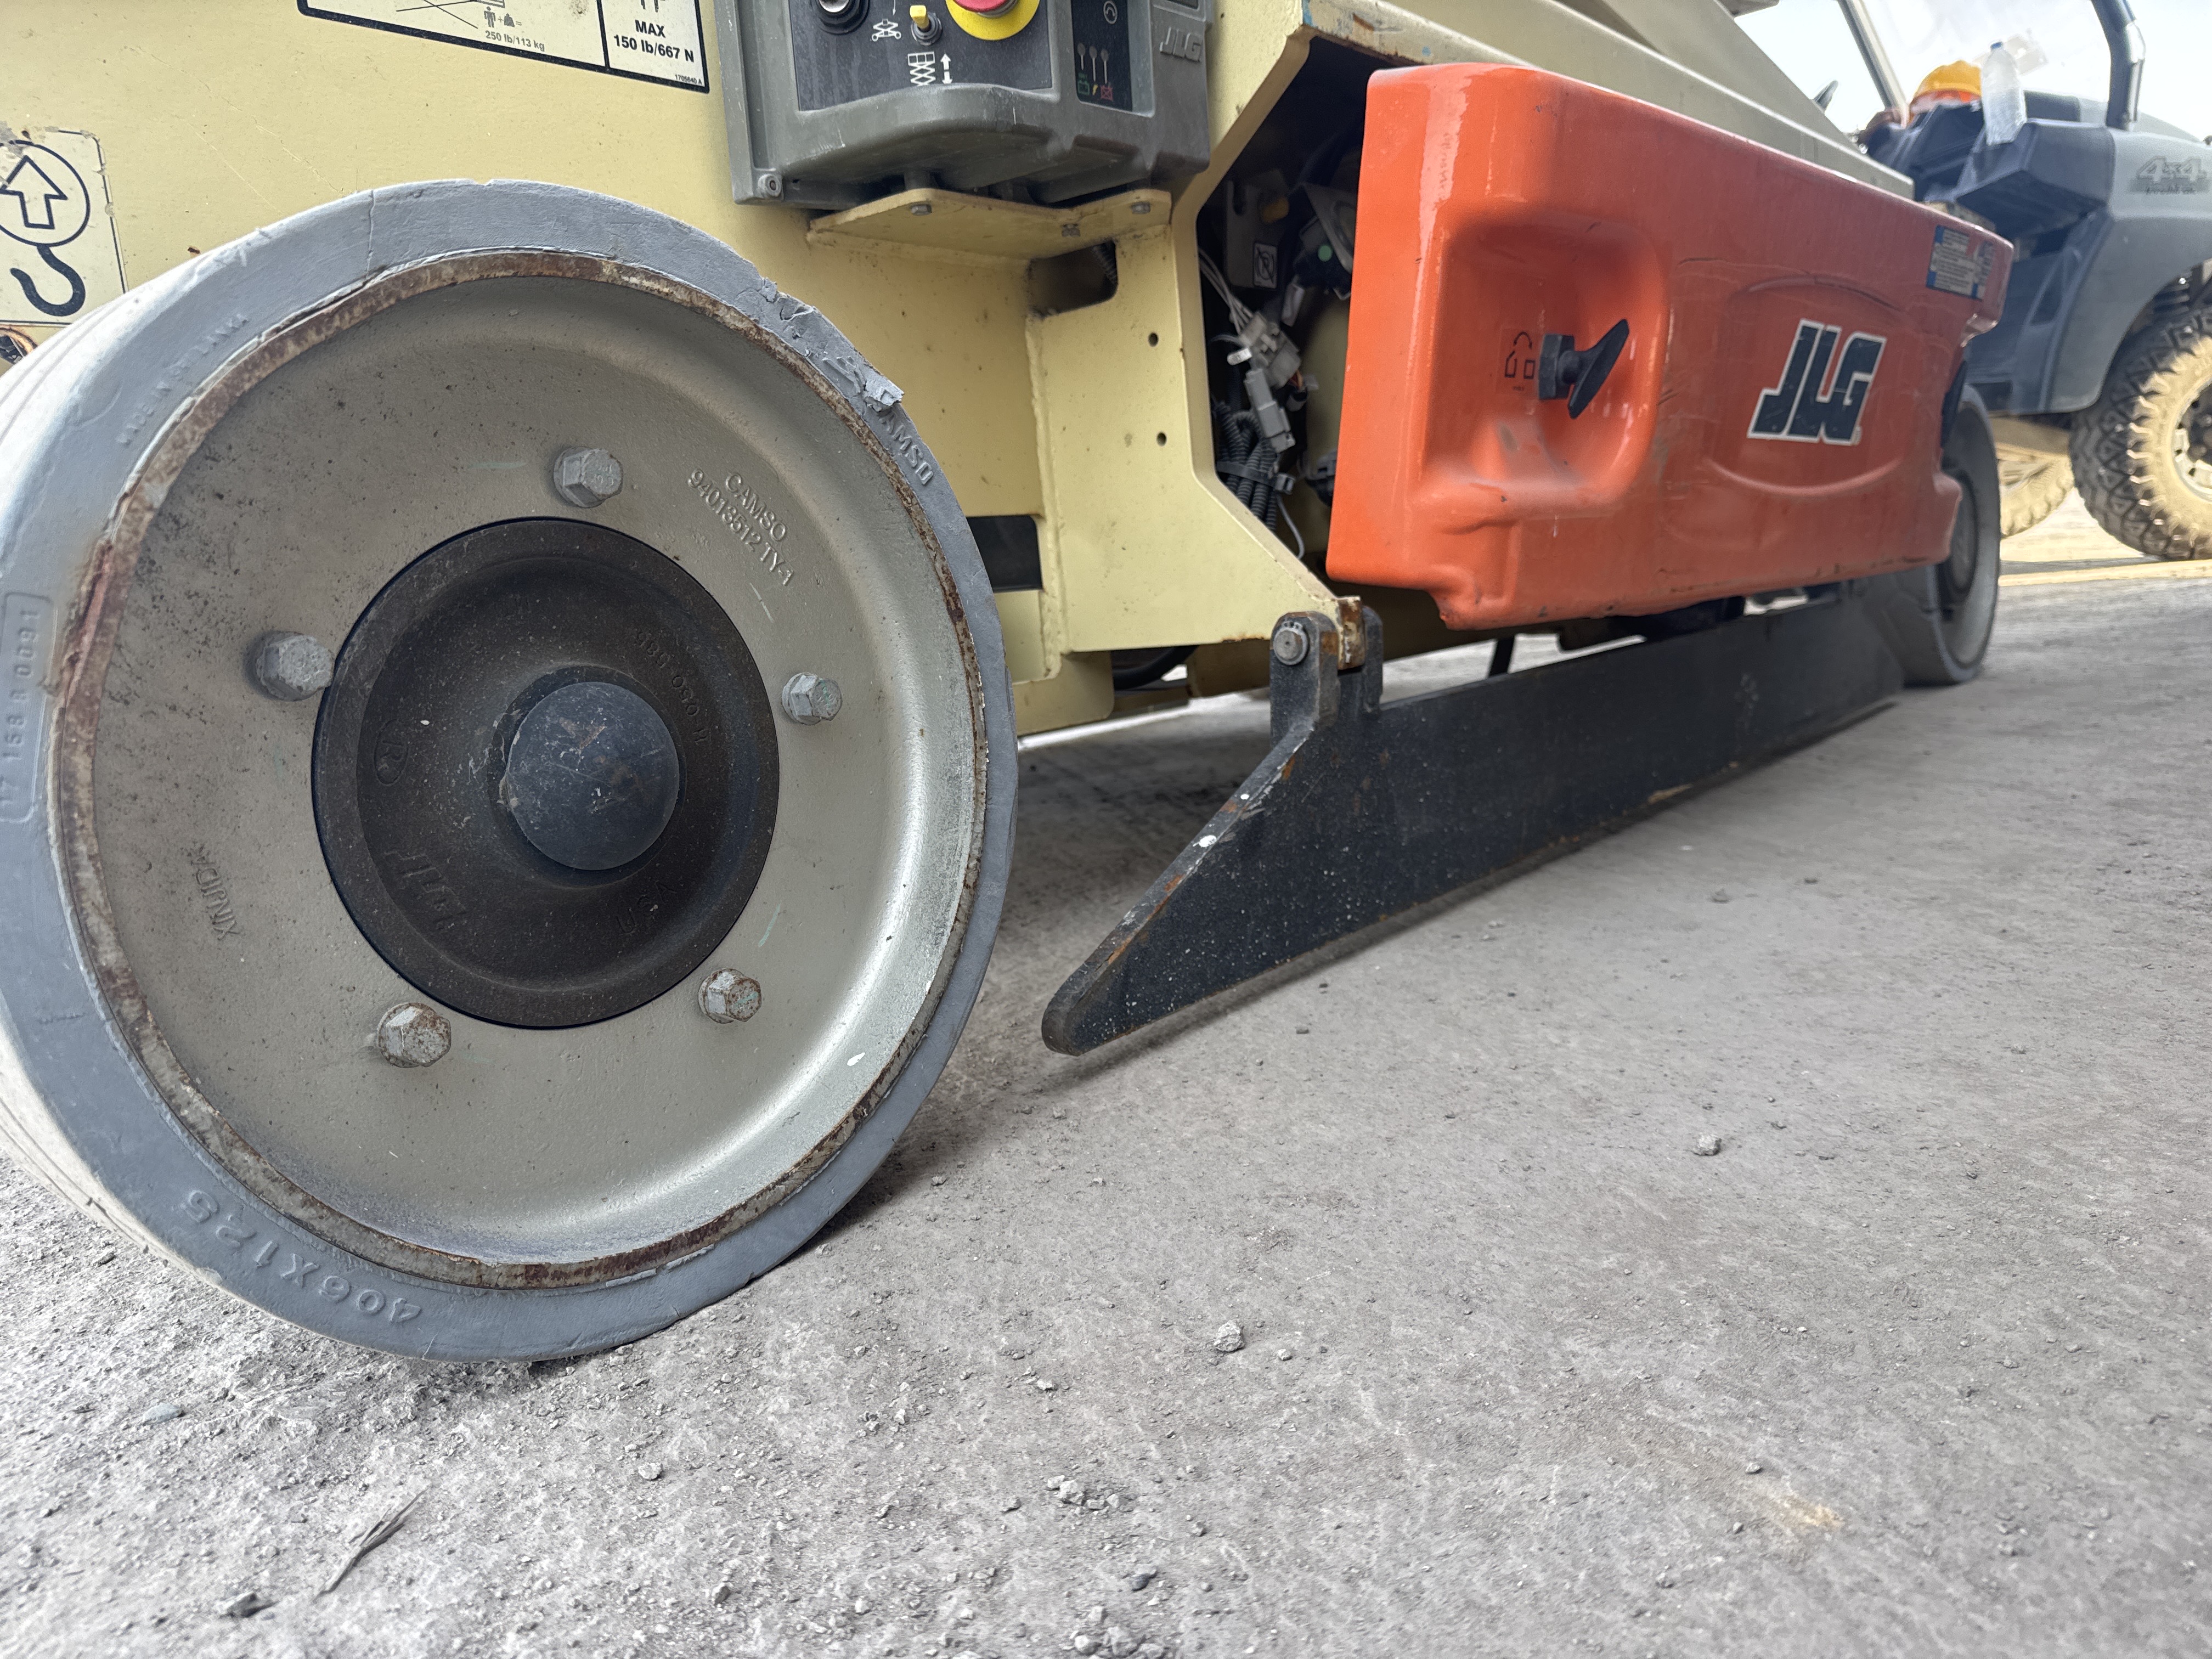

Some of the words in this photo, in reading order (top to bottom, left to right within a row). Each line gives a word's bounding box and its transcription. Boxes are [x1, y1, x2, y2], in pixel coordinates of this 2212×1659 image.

[485, 30, 502, 41] 250
[504, 33, 532, 47] lb/113
[533, 39, 545, 52] kg
[613, 34, 637, 50] 150
[641, 39, 680, 59] lb/667
[684, 48, 694, 63] N
[635, 19, 666, 38] MAX
[1159, 26, 1201, 63] JLG
[1747, 318, 1887, 446] JLG
[878, 410, 934, 486] AMSO
[725, 473, 787, 541] CAMSO
[759, 541, 795, 586] TY-1
